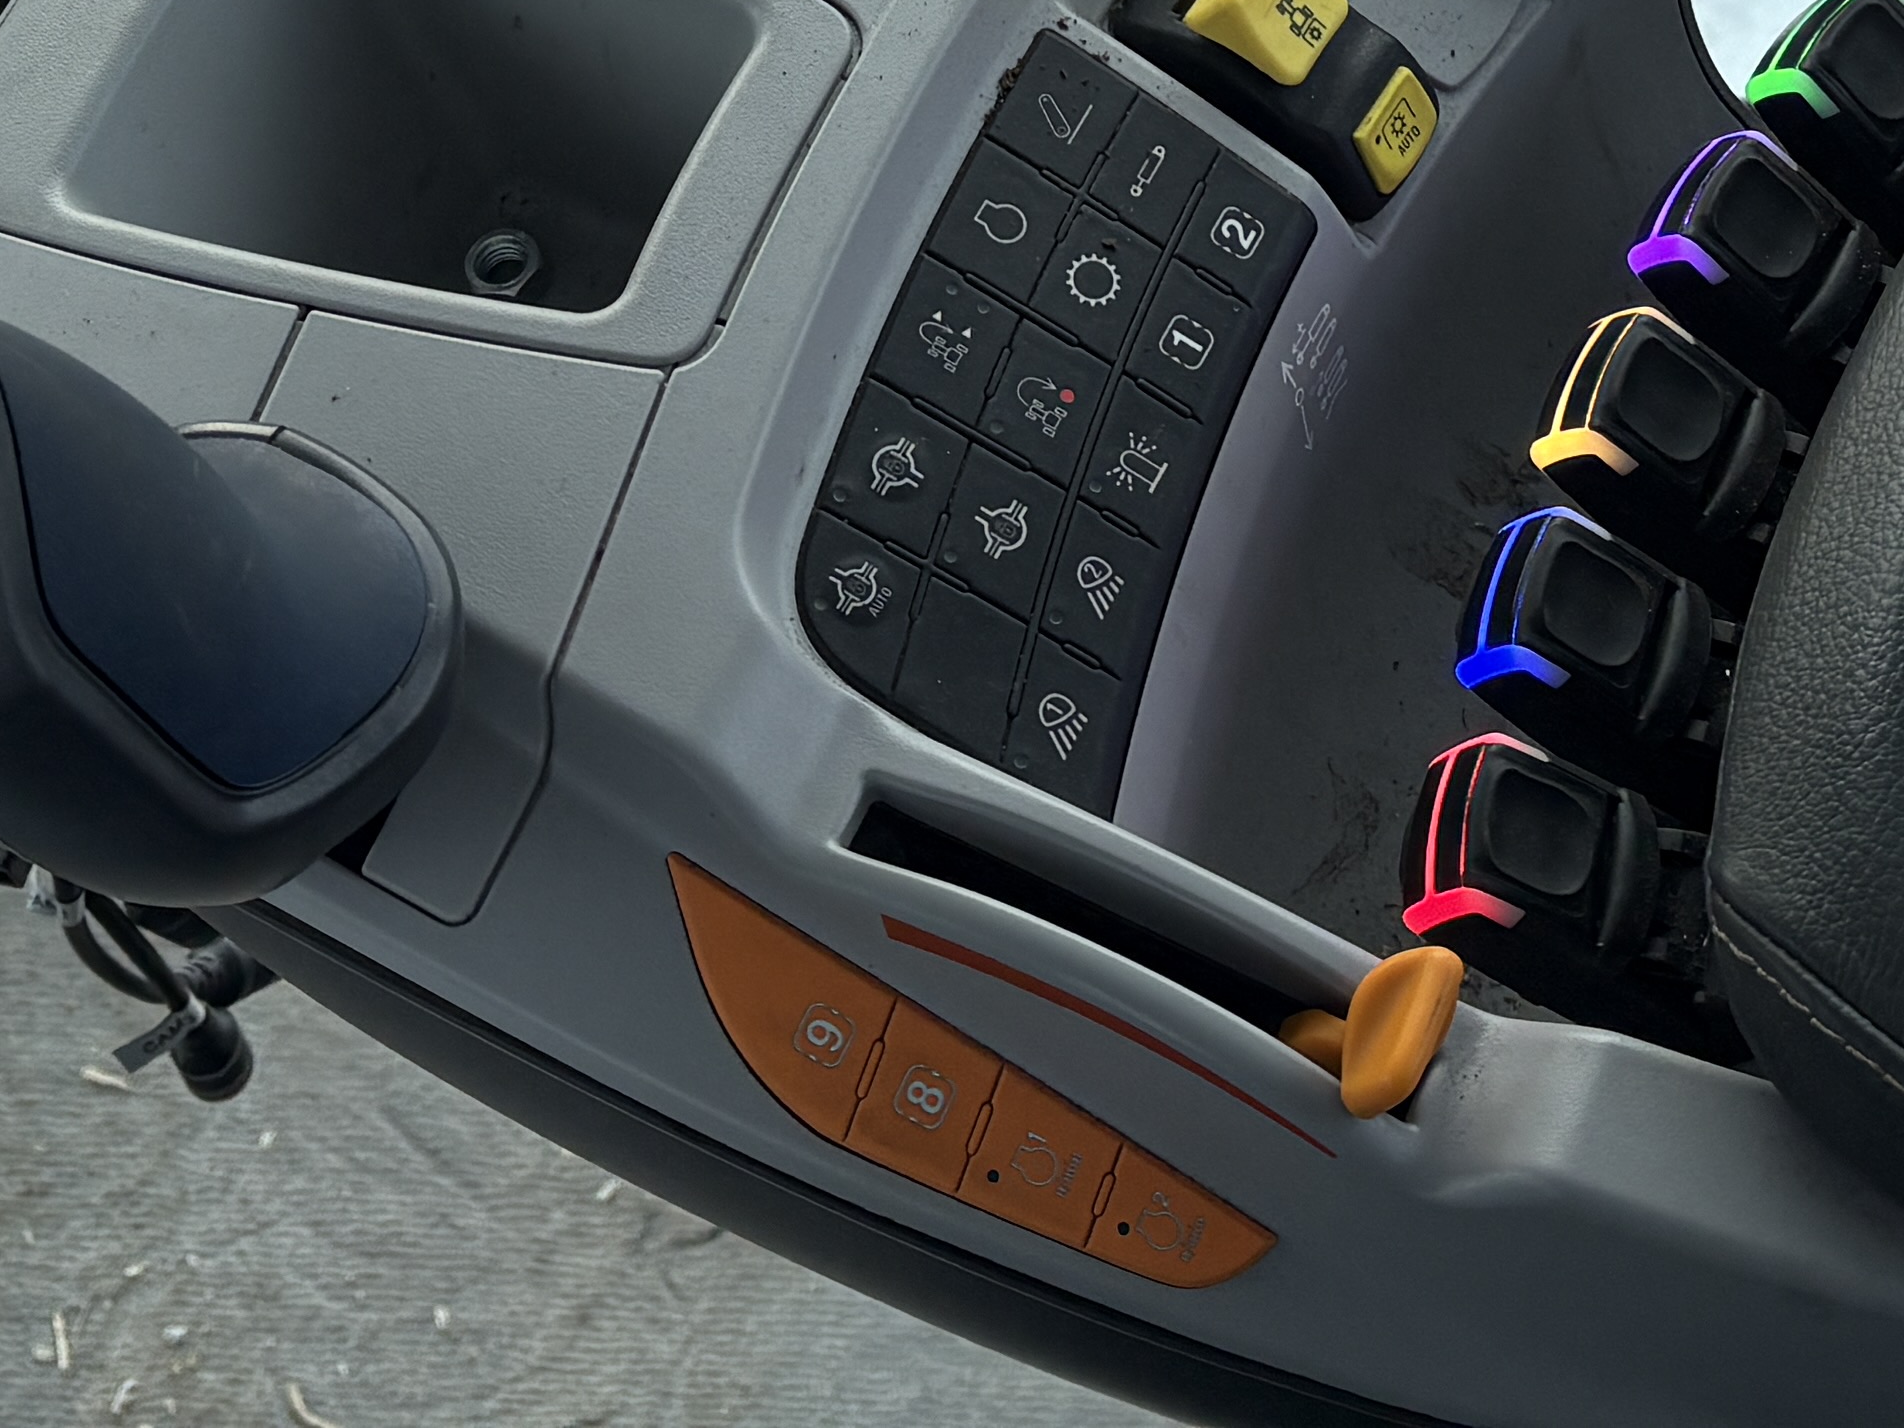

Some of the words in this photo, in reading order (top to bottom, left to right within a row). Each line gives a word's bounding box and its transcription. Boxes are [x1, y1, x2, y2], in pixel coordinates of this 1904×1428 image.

[1397, 125, 1422, 157] AUTO
[1220, 218, 1257, 250] 2
[1171, 329, 1204, 352] 1
[1082, 562, 1103, 580] 2
[868, 586, 893, 618] AUTO
[1046, 702, 1064, 716] 1
[805, 1018, 844, 1053] 9
[906, 1080, 946, 1115] 8
